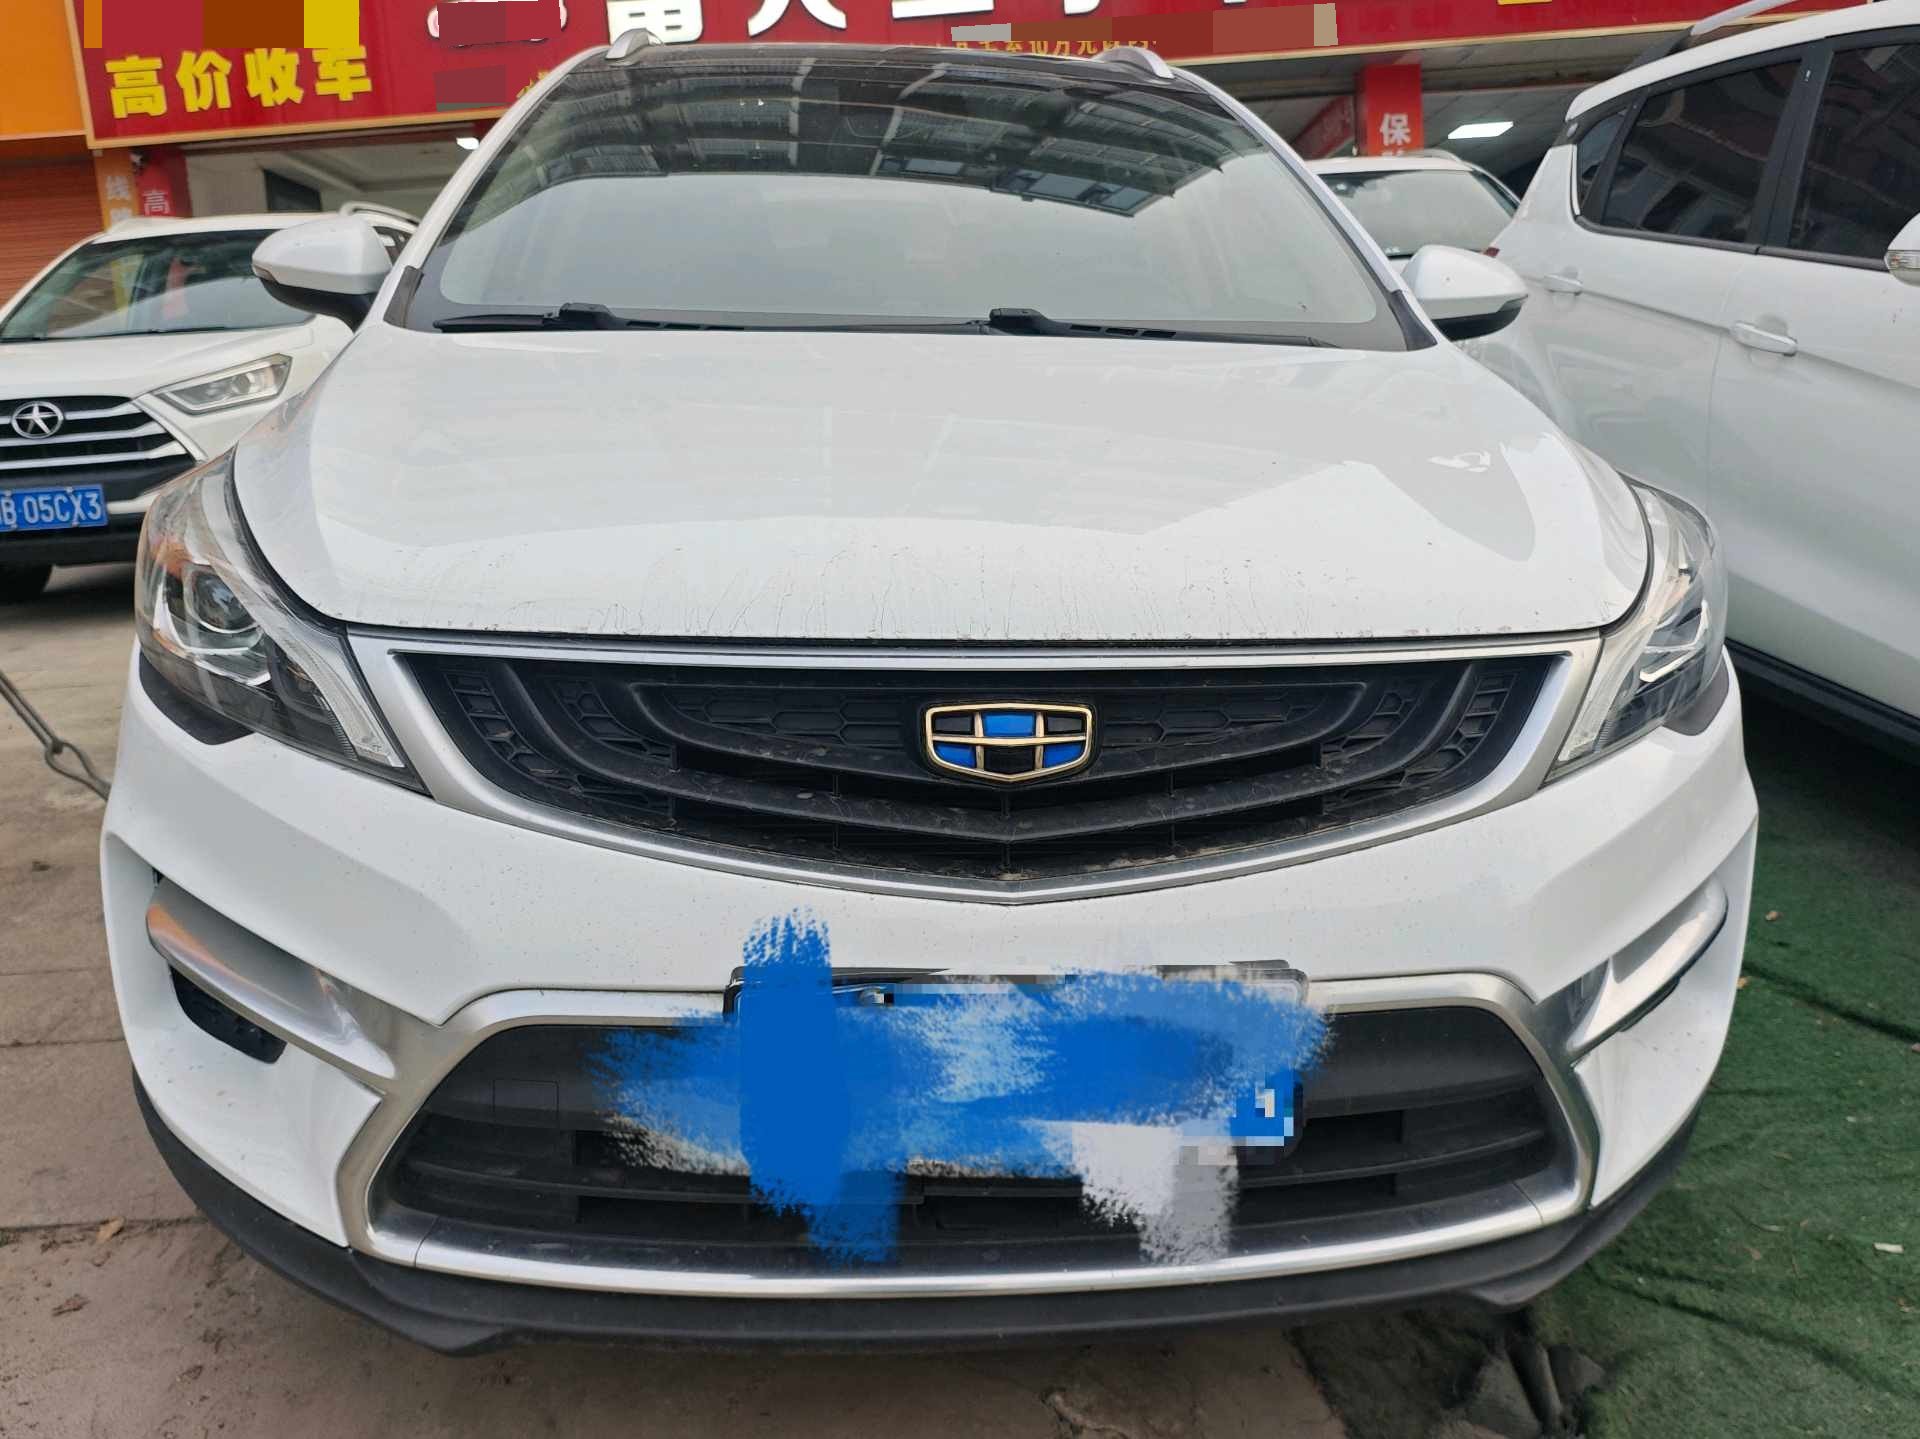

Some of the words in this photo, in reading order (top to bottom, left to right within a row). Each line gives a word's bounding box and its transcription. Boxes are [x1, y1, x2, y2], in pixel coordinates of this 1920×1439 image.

[105, 46, 372, 119] 高价收车
[142, 189, 170, 217] 高
